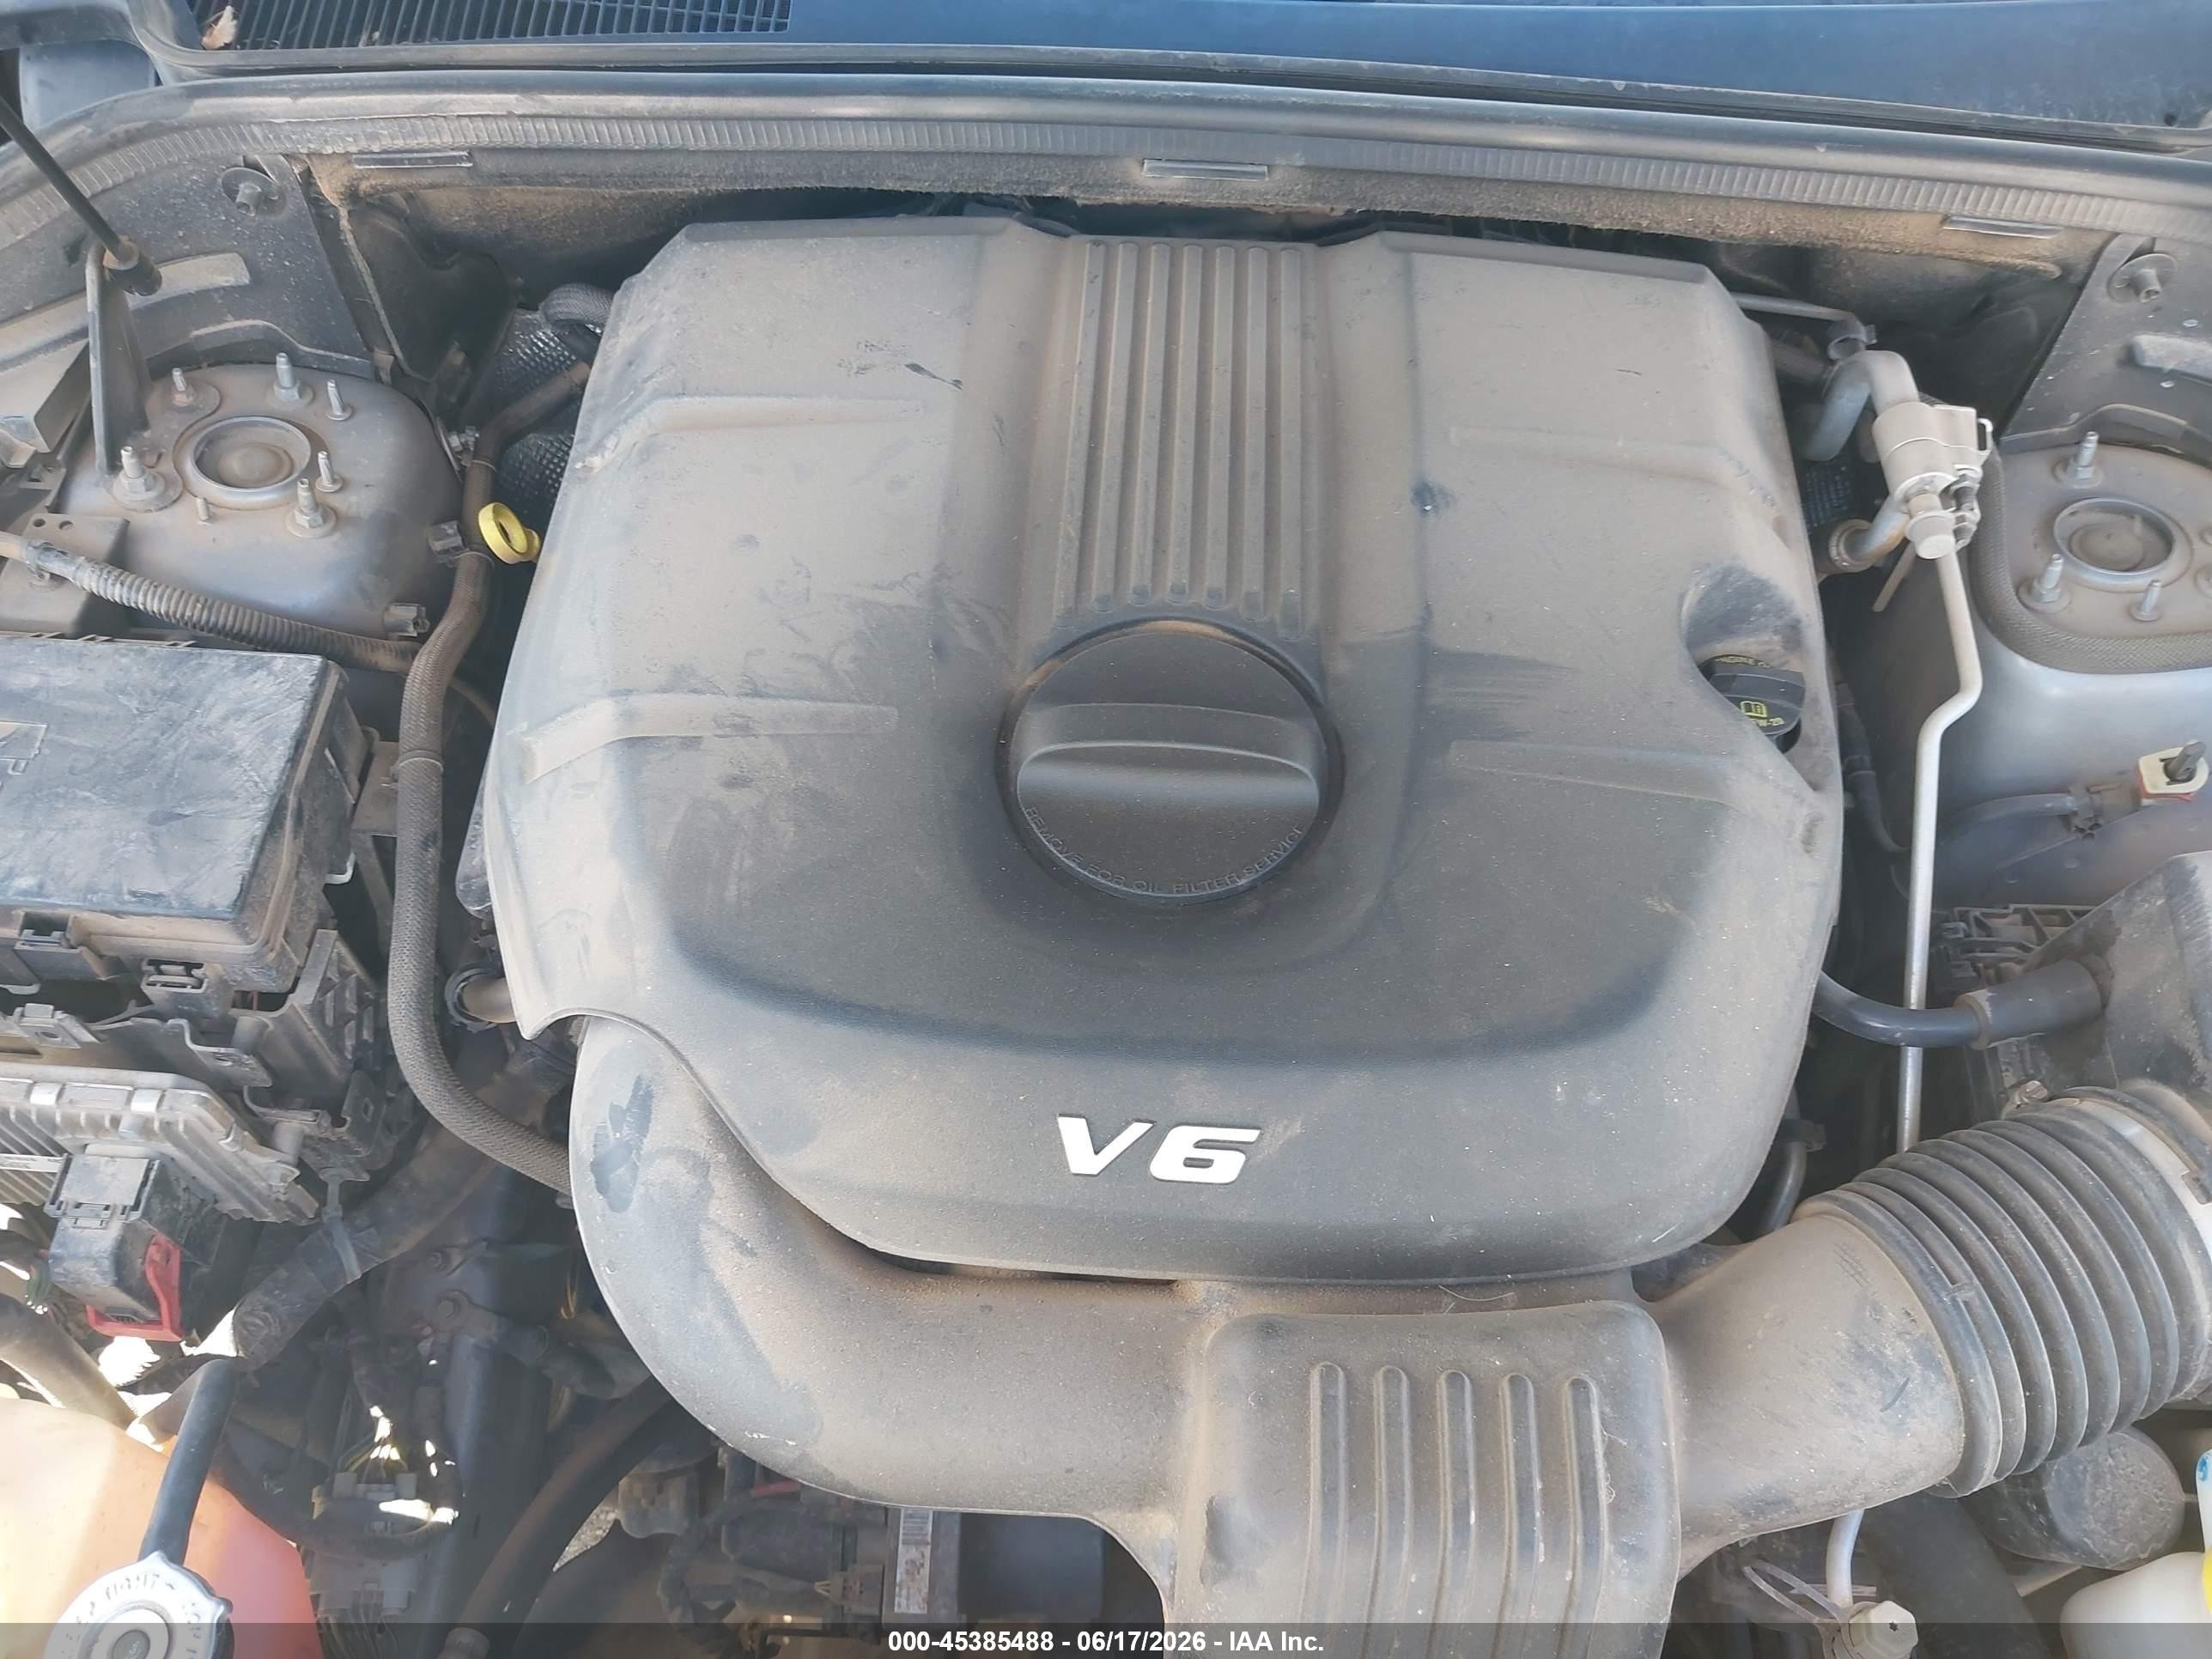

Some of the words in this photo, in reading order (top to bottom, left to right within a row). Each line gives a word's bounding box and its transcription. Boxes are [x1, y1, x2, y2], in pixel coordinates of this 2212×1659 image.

[1024, 806, 1085, 865] REMOVE
[1088, 863, 1126, 887] FOR
[1133, 880, 1162, 893] OIL
[1173, 872, 1241, 894] FILTER
[1057, 1114, 1261, 1184] V6
